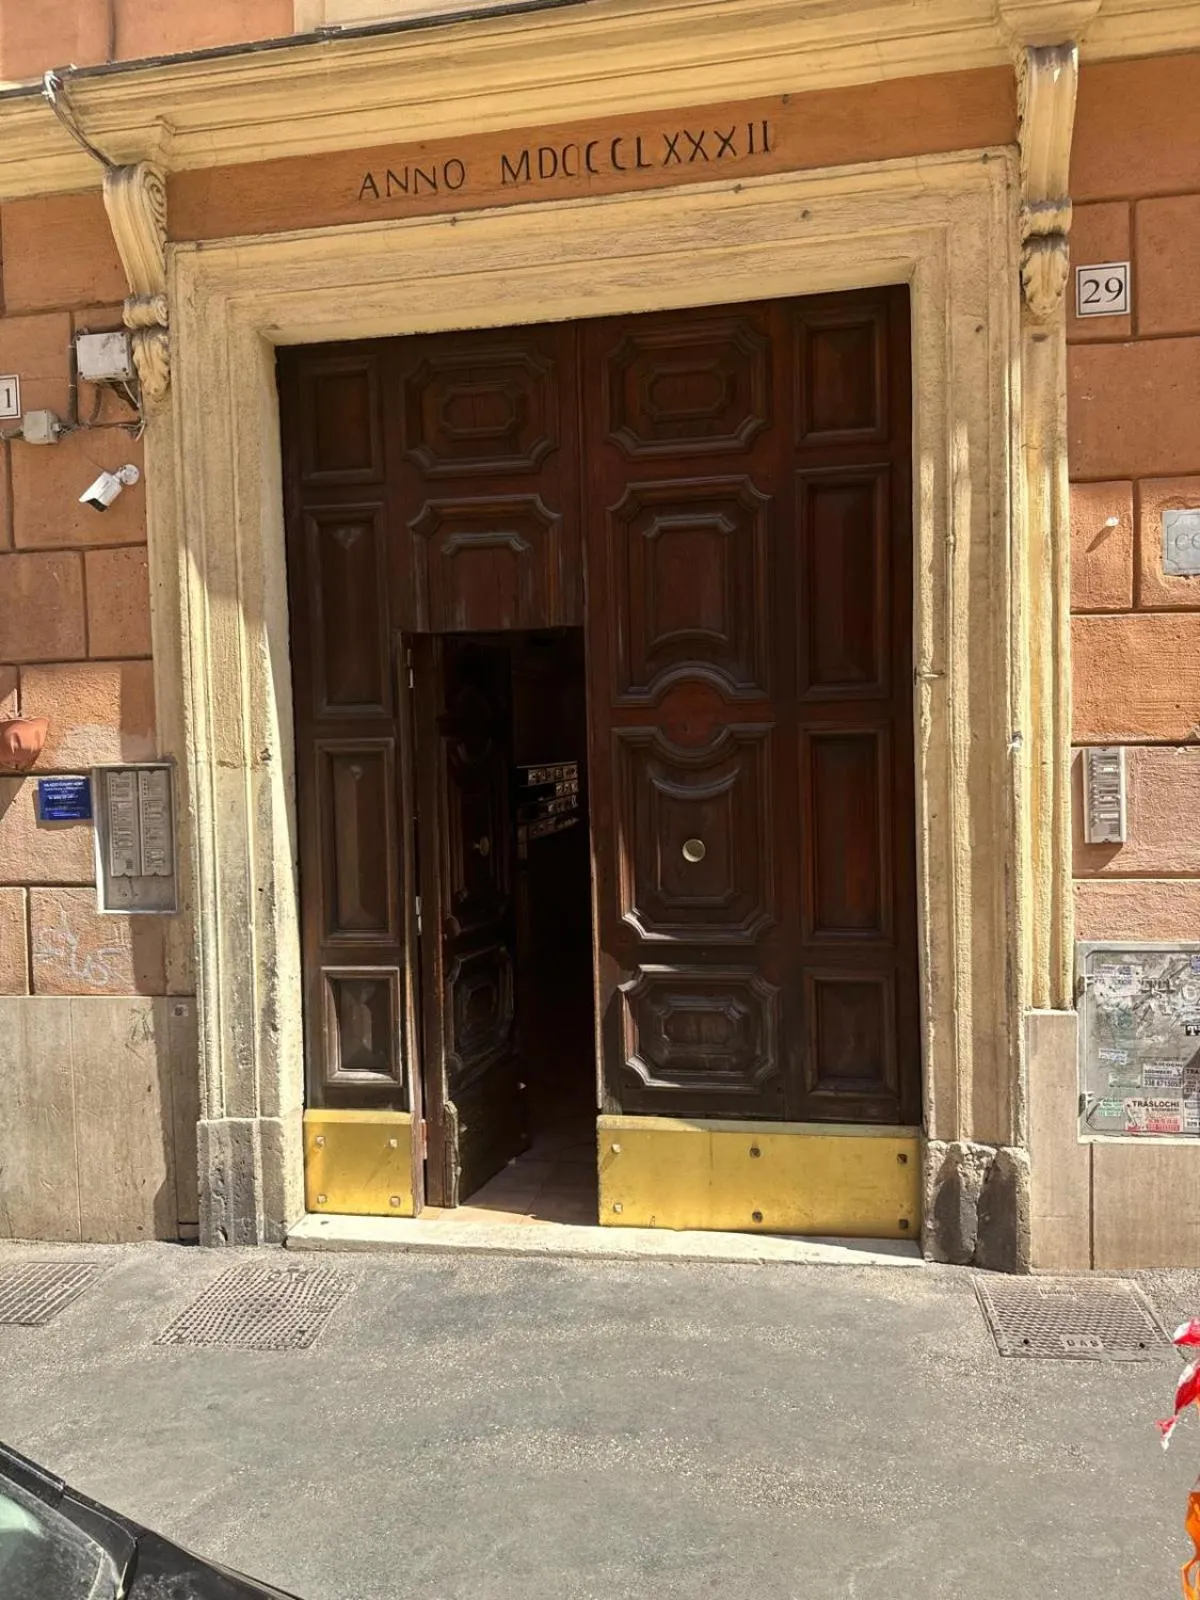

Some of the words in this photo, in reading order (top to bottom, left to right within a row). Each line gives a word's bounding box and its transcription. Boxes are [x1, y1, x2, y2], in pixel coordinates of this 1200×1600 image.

[359, 158, 465, 200] ANNO
[501, 120, 769, 185] MDCCCLXXXII
[1082, 277, 1123, 304] 29
